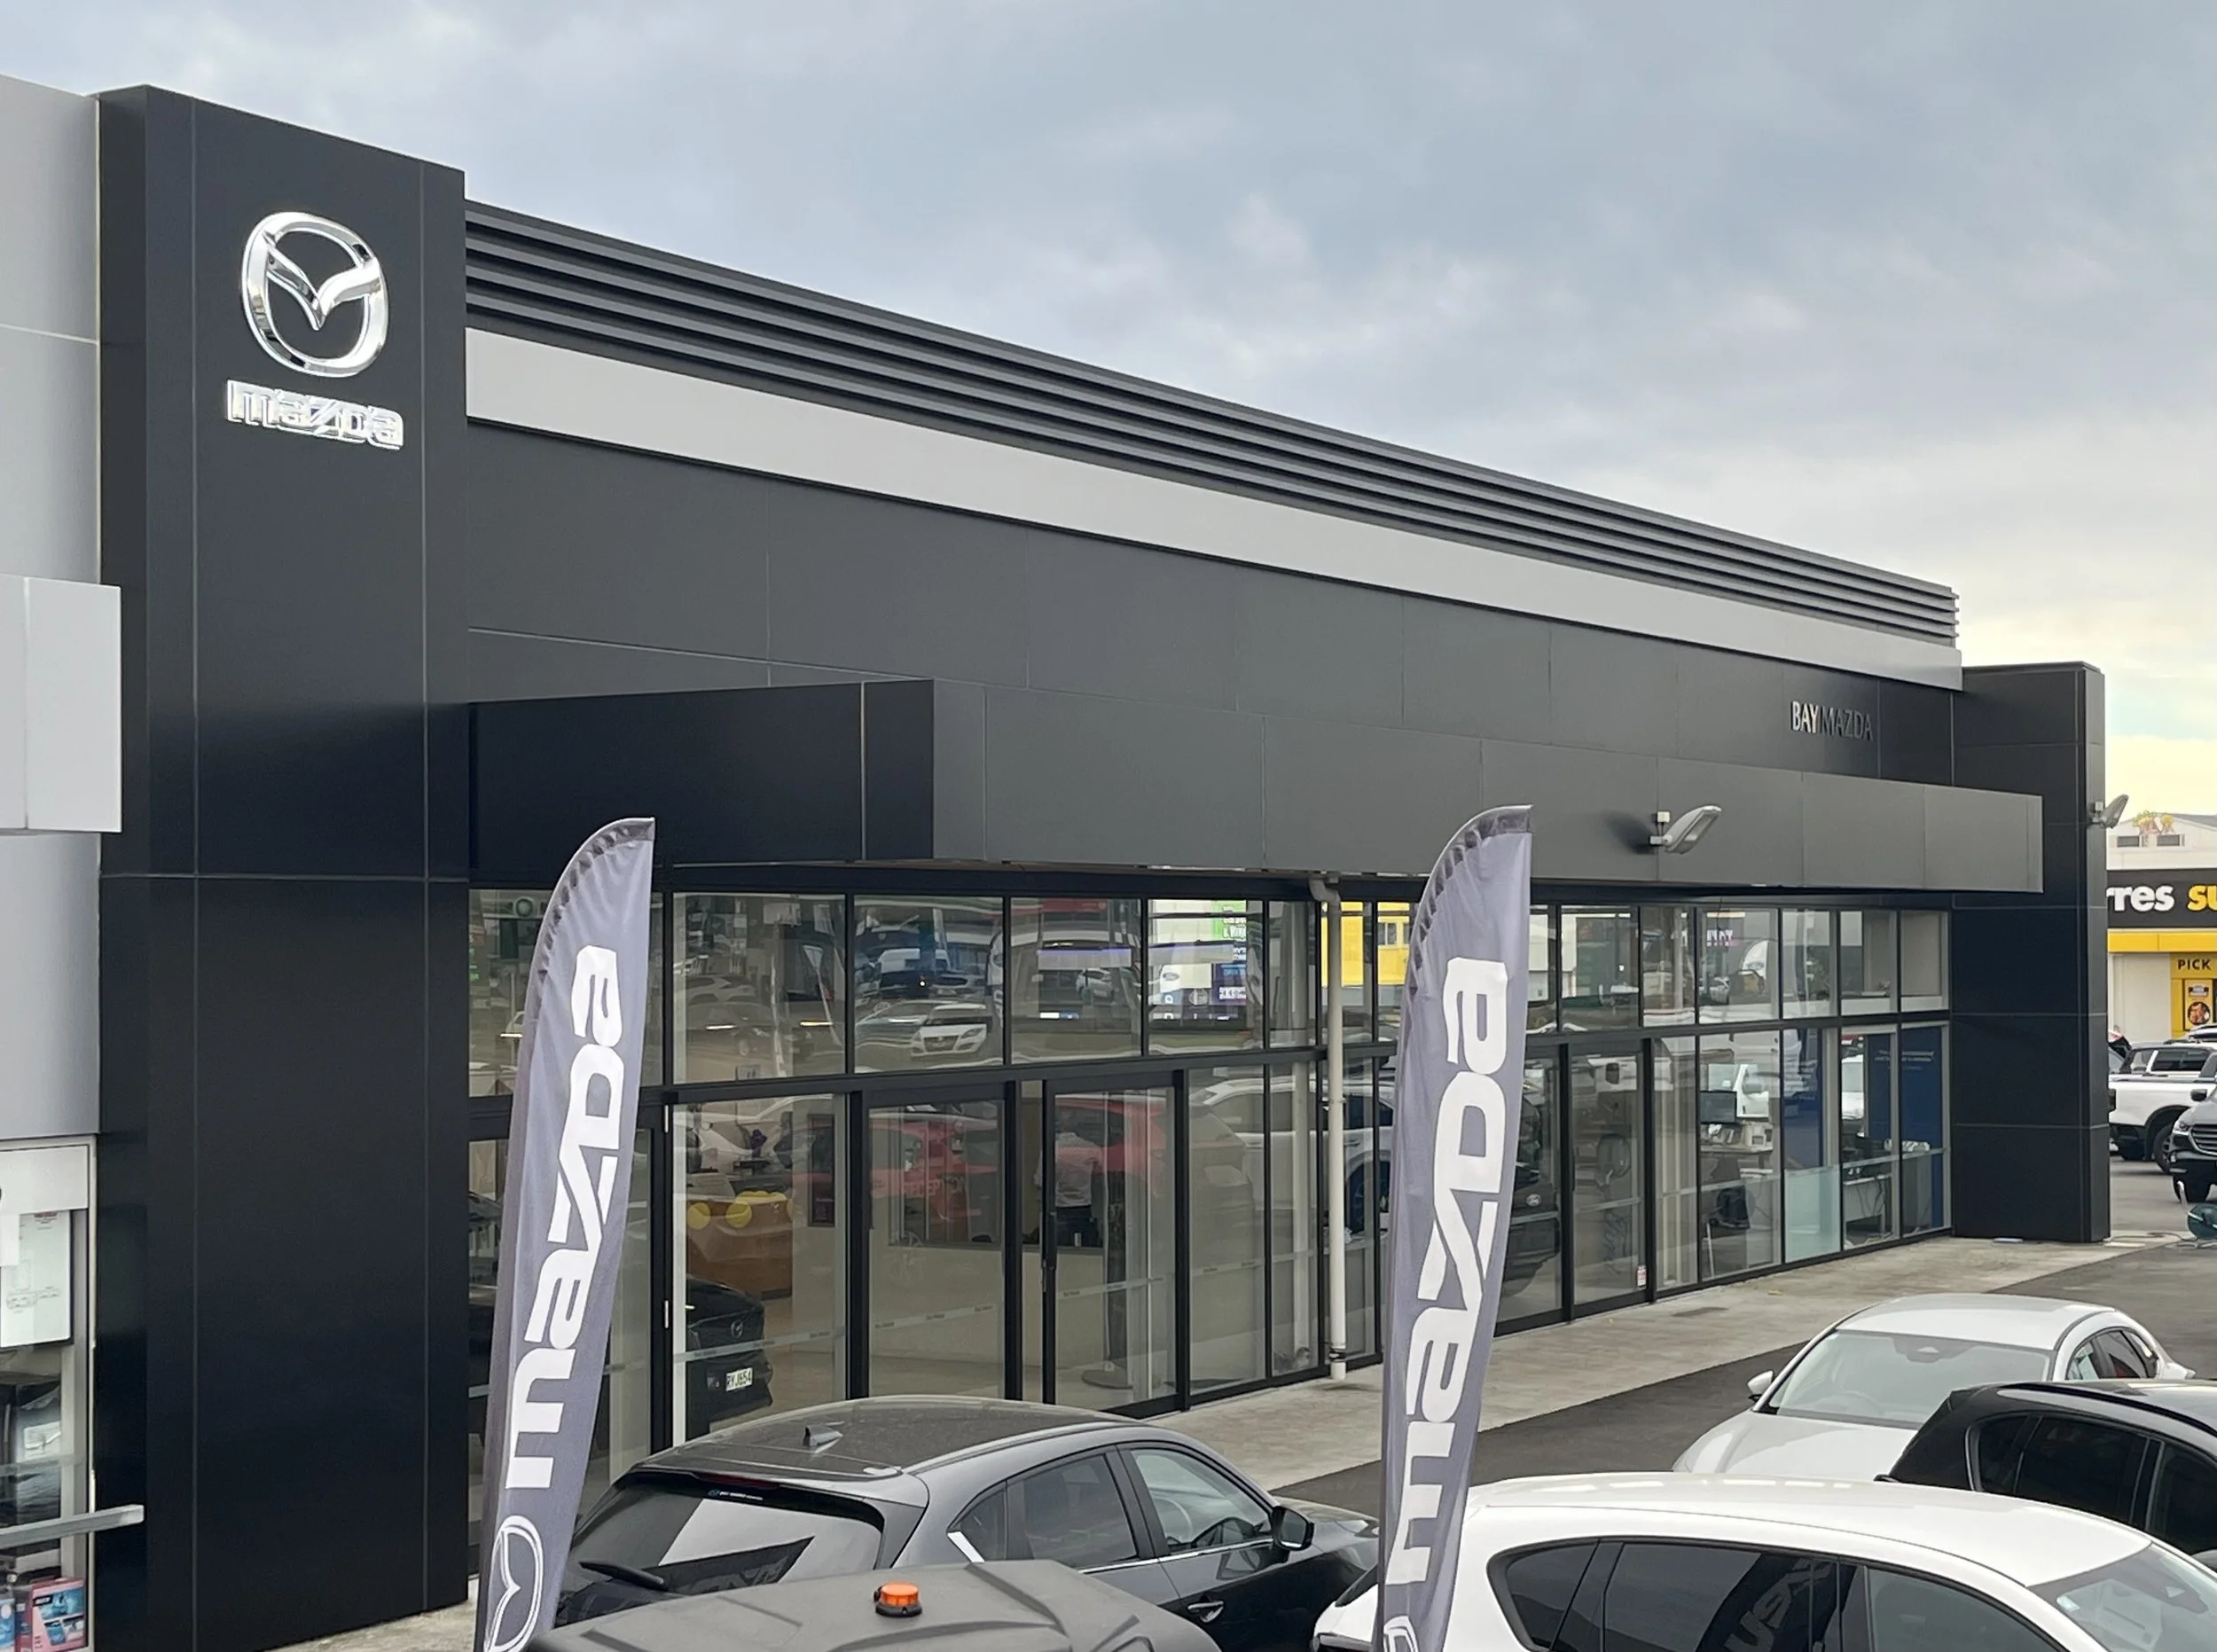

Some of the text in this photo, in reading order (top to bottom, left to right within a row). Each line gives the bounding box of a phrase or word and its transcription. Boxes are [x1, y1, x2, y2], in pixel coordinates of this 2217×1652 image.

[227, 380, 404, 450] mazda
[1790, 701, 1874, 741] BAY MAZDA
[2177, 959, 2212, 971] PICK
[505, 944, 624, 1490] mazda
[1383, 957, 1508, 1586] mazda
